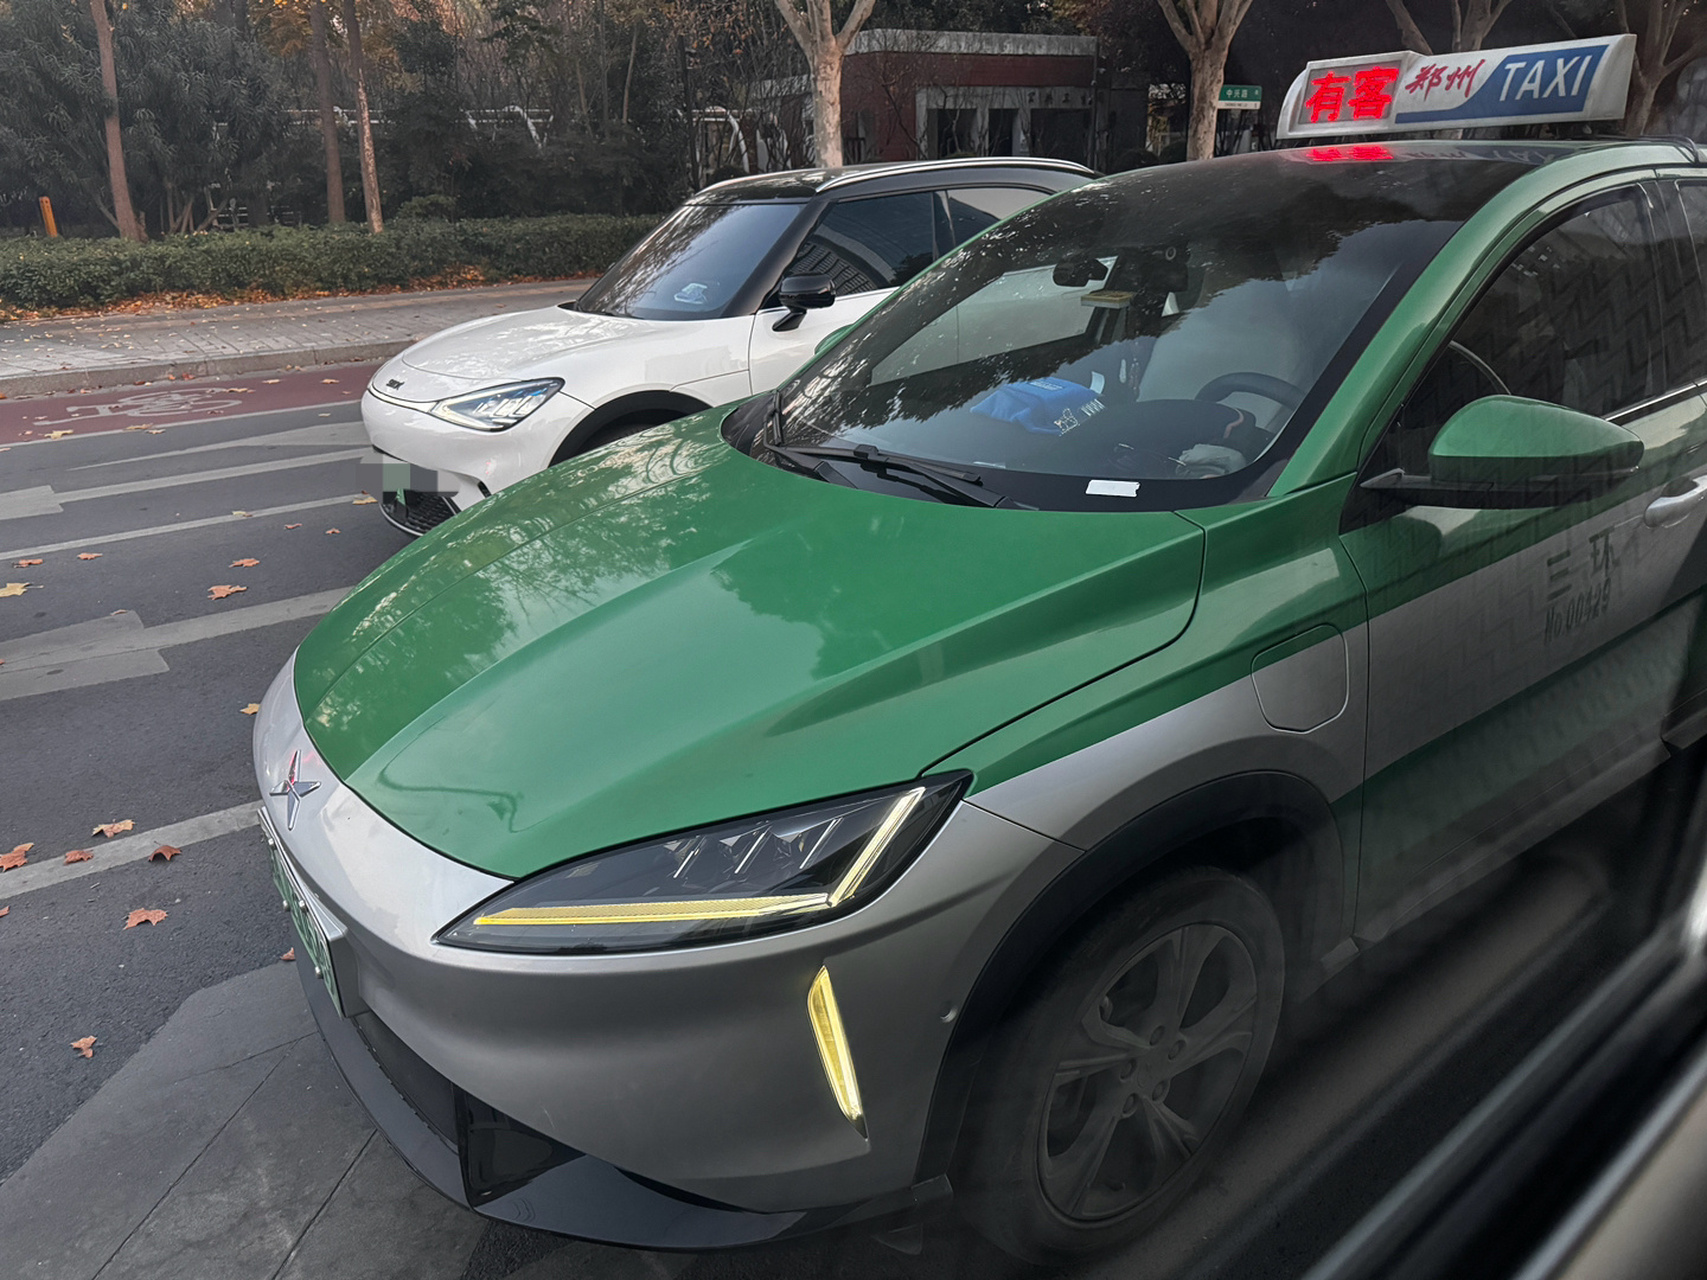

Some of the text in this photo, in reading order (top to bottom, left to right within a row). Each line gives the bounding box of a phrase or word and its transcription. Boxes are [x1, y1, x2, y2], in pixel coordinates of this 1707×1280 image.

[1305, 66, 1400, 123] 有客
[1405, 54, 1593, 102] 郑州 TAXI
